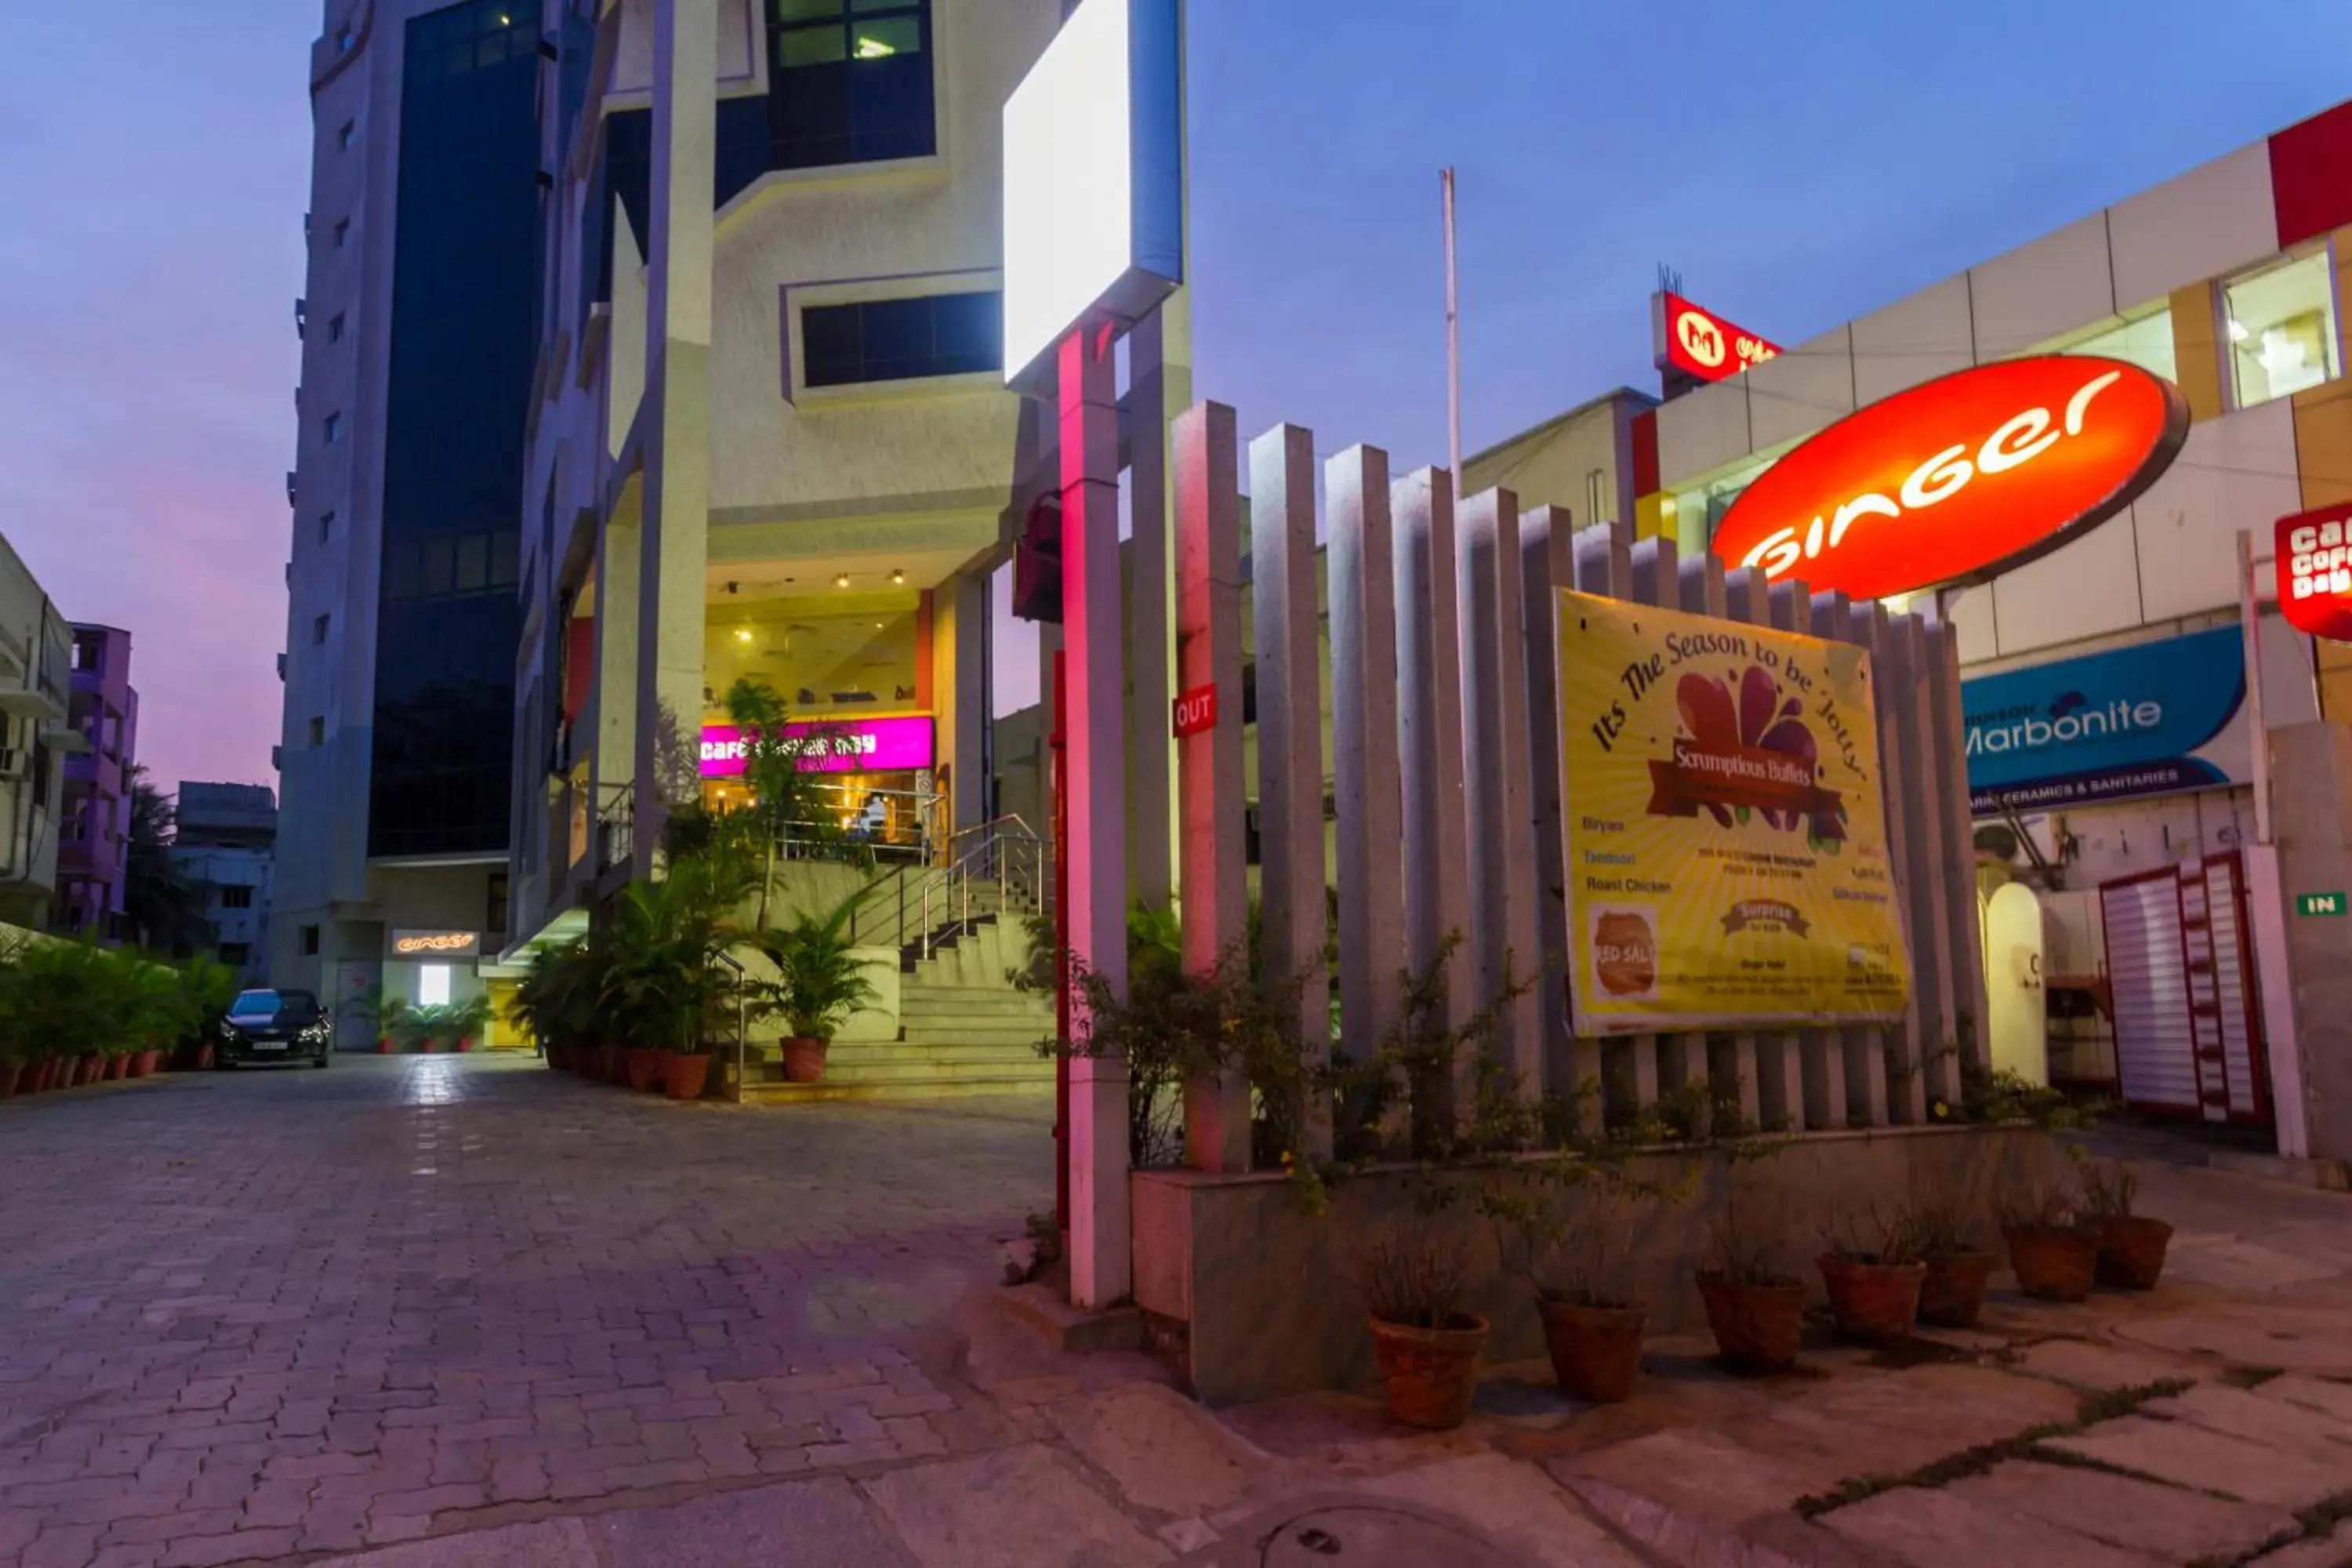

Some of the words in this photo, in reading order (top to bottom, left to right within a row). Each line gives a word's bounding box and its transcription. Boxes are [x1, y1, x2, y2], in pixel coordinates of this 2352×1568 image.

[1621, 652, 1665, 702] The
[1665, 631, 1748, 665] Season
[1754, 643, 1779, 668] to
[1784, 655, 1813, 695] be
[1176, 694, 1211, 728] OUT
[1675, 745, 1766, 780] Scrumptious
[1766, 759, 1812, 786] Buffets
[2077, 782, 2088, 794] &
[2090, 768, 2180, 793] SANITARIES
[1587, 876, 1622, 892] Roast
[1625, 877, 1673, 895] Chicken
[2308, 896, 2336, 913] IN
